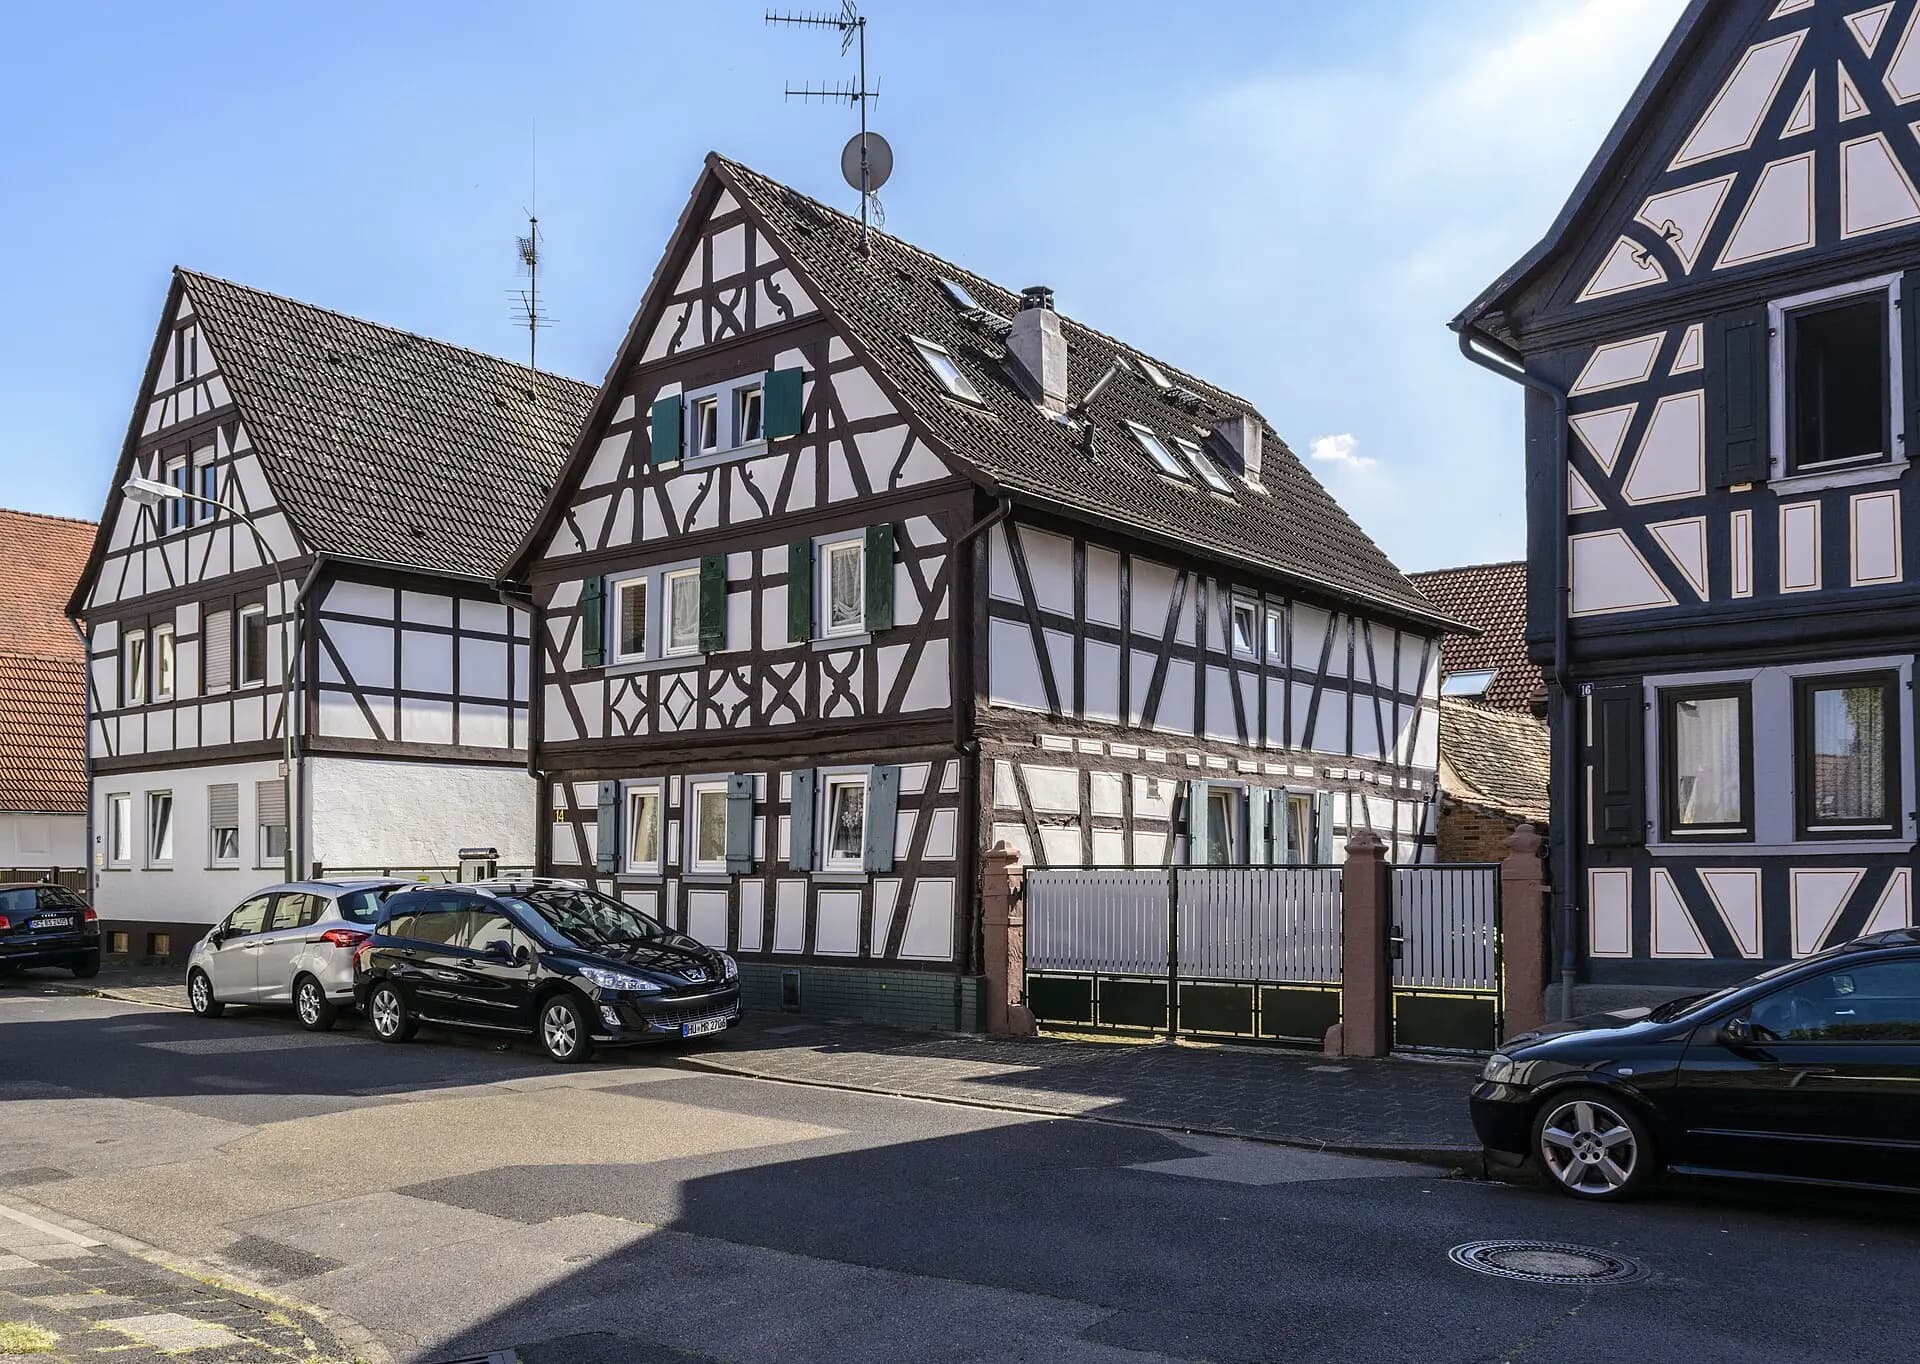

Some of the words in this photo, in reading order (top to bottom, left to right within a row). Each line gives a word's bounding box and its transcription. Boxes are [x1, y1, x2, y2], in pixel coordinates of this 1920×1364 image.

[1581, 685, 1591, 695] 16
[556, 809, 564, 823] 14
[688, 1023, 697, 1034] HU
[701, 1021, 710, 1032] MR
